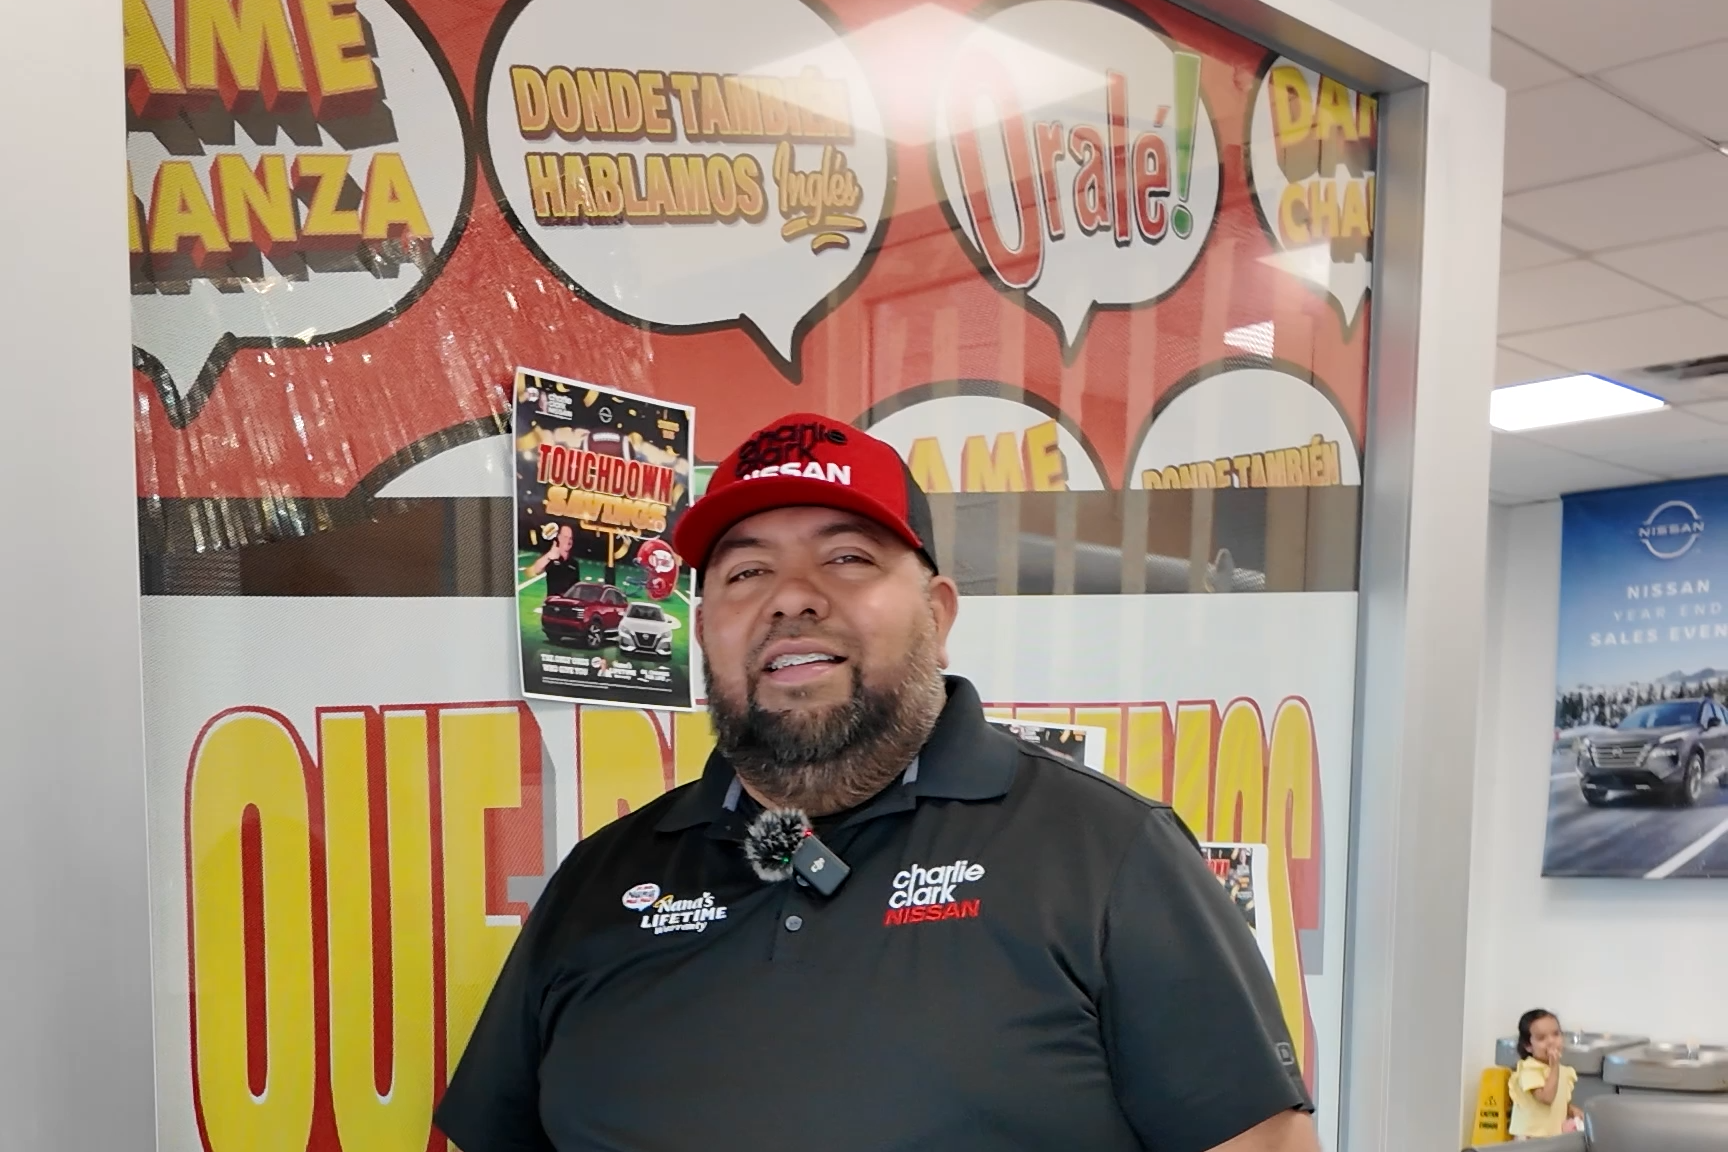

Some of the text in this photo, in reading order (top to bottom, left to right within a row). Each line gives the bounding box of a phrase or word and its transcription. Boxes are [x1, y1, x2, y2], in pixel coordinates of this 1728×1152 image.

[511, 65, 677, 141] DONDE
[525, 140, 866, 228] HABLAMOS Inglés
[128, 152, 435, 262] ANZA
[1279, 177, 1375, 244] CHA
[537, 443, 676, 506] TOUCHDOWN
[1638, 521, 1705, 537] NISSAN
[1626, 579, 1710, 600] NISSAN
[1613, 601, 1722, 622] YEAR END
[1589, 628, 1659, 647] SALES
[892, 860, 985, 890] charlie
[653, 891, 716, 913] Nana's
[888, 884, 957, 908] clark
[640, 906, 728, 929] LIFETIME
[883, 898, 981, 926] NISSAN
